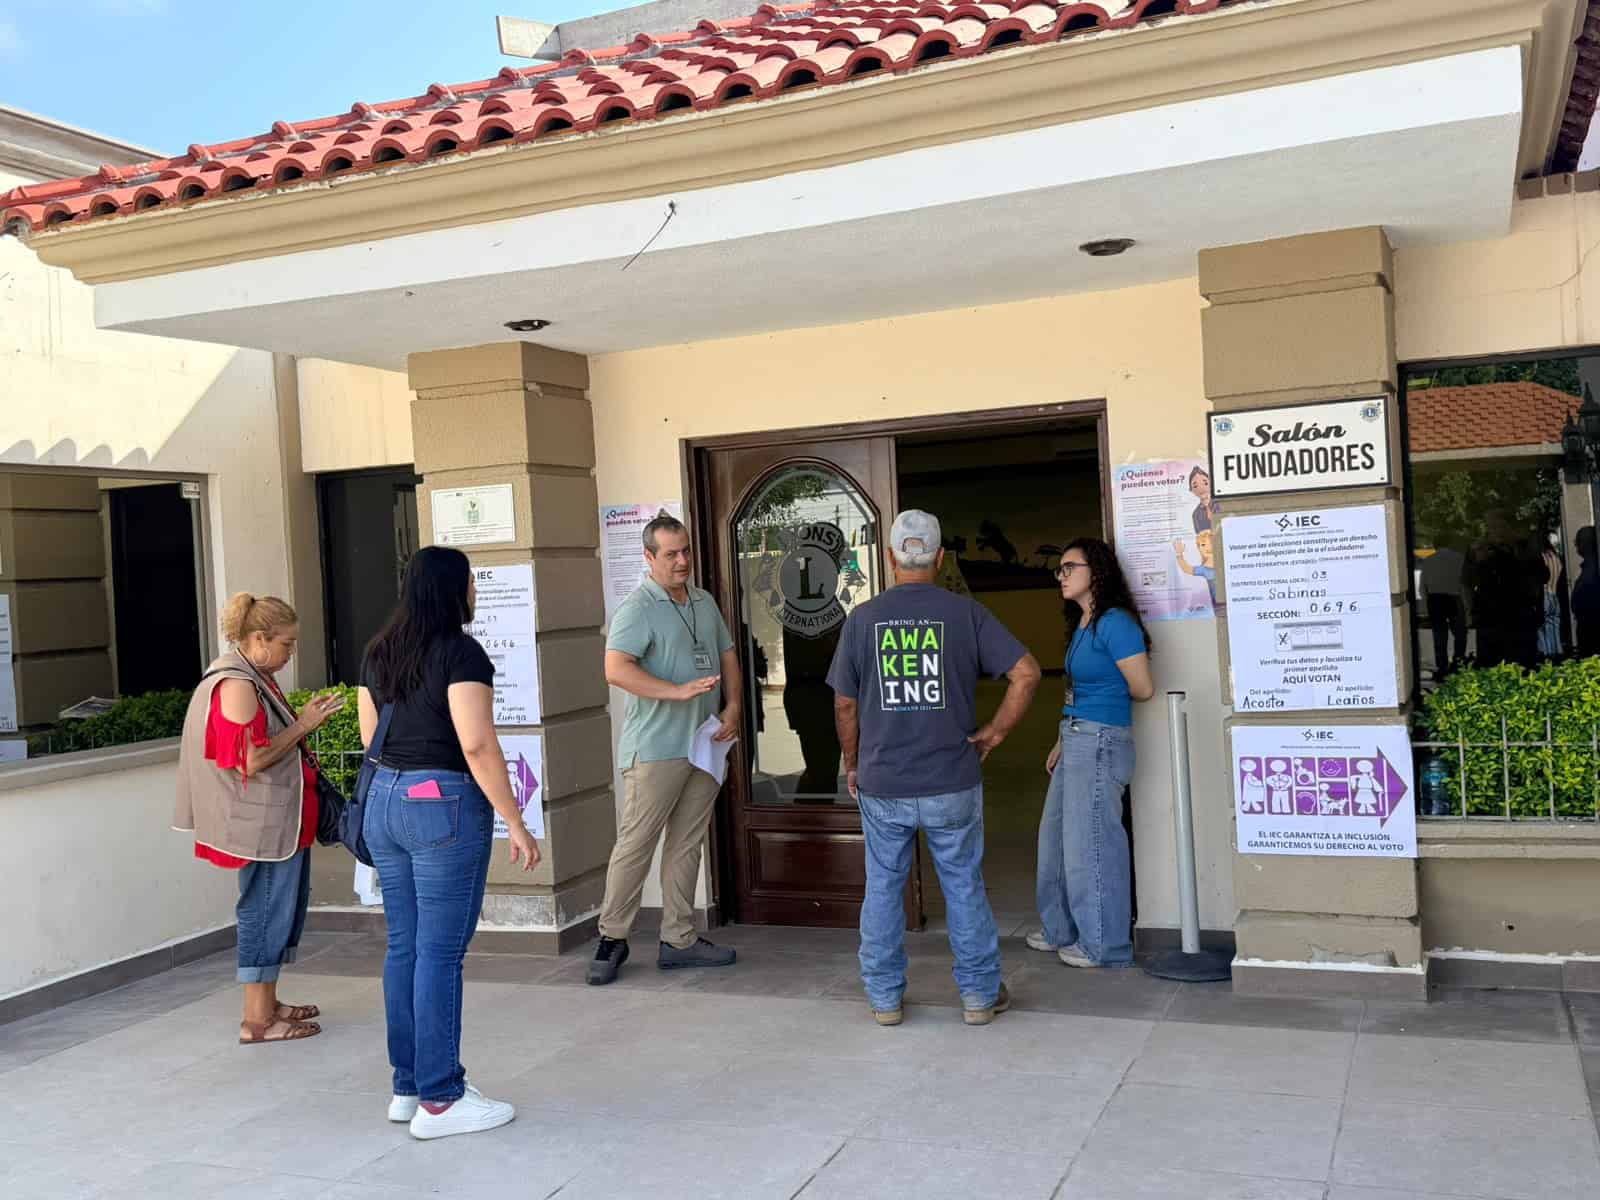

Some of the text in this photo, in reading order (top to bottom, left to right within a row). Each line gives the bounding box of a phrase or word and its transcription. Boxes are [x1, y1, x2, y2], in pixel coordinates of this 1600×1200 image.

[1248, 421, 1347, 448] Salón
[1224, 443, 1375, 481] FUNDADORES
[1121, 475, 1185, 492] pueden votar?
[1296, 515, 1321, 528] IEC
[477, 571, 493, 580] IEC
[797, 557, 825, 600] L
[1268, 587, 1327, 601] Sabinas
[1257, 609, 1301, 620] SECCIÓN:
[881, 628, 939, 651] AWA
[882, 654, 939, 677] KEN
[1287, 657, 1298, 665] tus
[1299, 656, 1319, 664] datos
[1282, 673, 1341, 685] AQUÍ VOTAN
[885, 680, 940, 704] ING
[1242, 695, 1376, 710] Acosta Leaños
[1316, 730, 1334, 739] IEC
[1269, 831, 1282, 839] IEC
[1283, 831, 1331, 841] GARANTIZA
[1332, 832, 1343, 840] LA
[1344, 831, 1391, 841] INCLUSIÓN
[1248, 841, 1404, 852] GARANTICEMOS SU DERECHO AL VOTO
